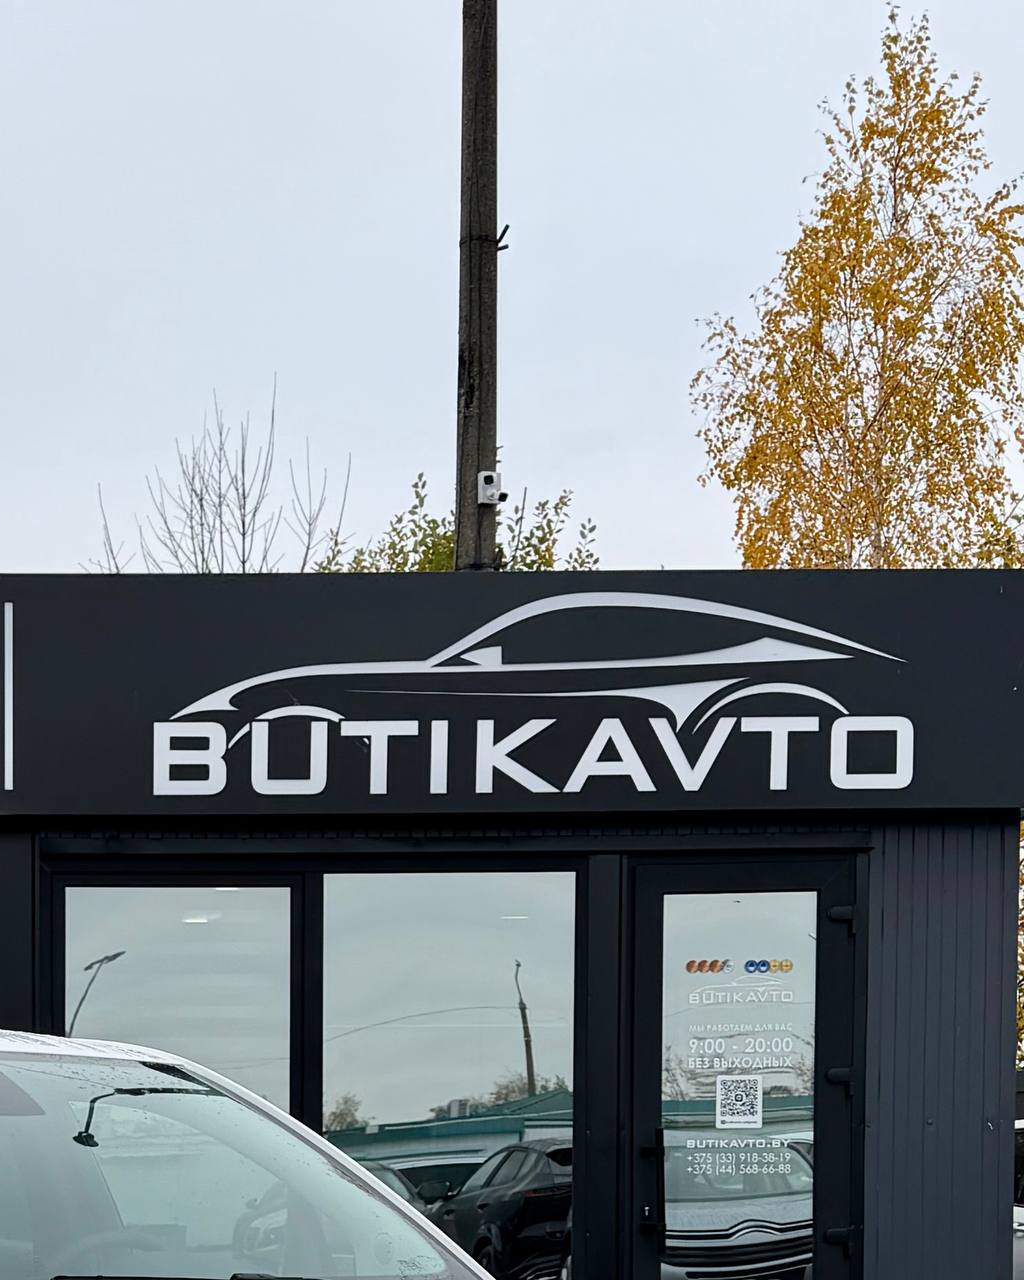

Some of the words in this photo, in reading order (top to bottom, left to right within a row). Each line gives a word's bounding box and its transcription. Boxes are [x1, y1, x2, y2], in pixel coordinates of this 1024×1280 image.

[152, 714, 915, 796] BUTIKAVTO
[688, 991, 793, 1004] BUTIKAVTO
[706, 1024, 753, 1032] РАБОТАЕМ
[775, 1023, 793, 1031] ВАС
[688, 1038, 725, 1054] 9:00
[744, 1038, 793, 1053] 20:00
[688, 1057, 710, 1069] БЕЗ
[713, 1056, 793, 1069] ВЫХОДНЫХ
[686, 1139, 791, 1149] BUTIKAVTO.BY
[687, 1153, 713, 1163] +375
[716, 1153, 736, 1165] (33)
[739, 1153, 791, 1163] 918-38-19
[687, 1164, 713, 1175] +375
[716, 1164, 736, 1176] (44)
[739, 1164, 791, 1175] 568-66-88
